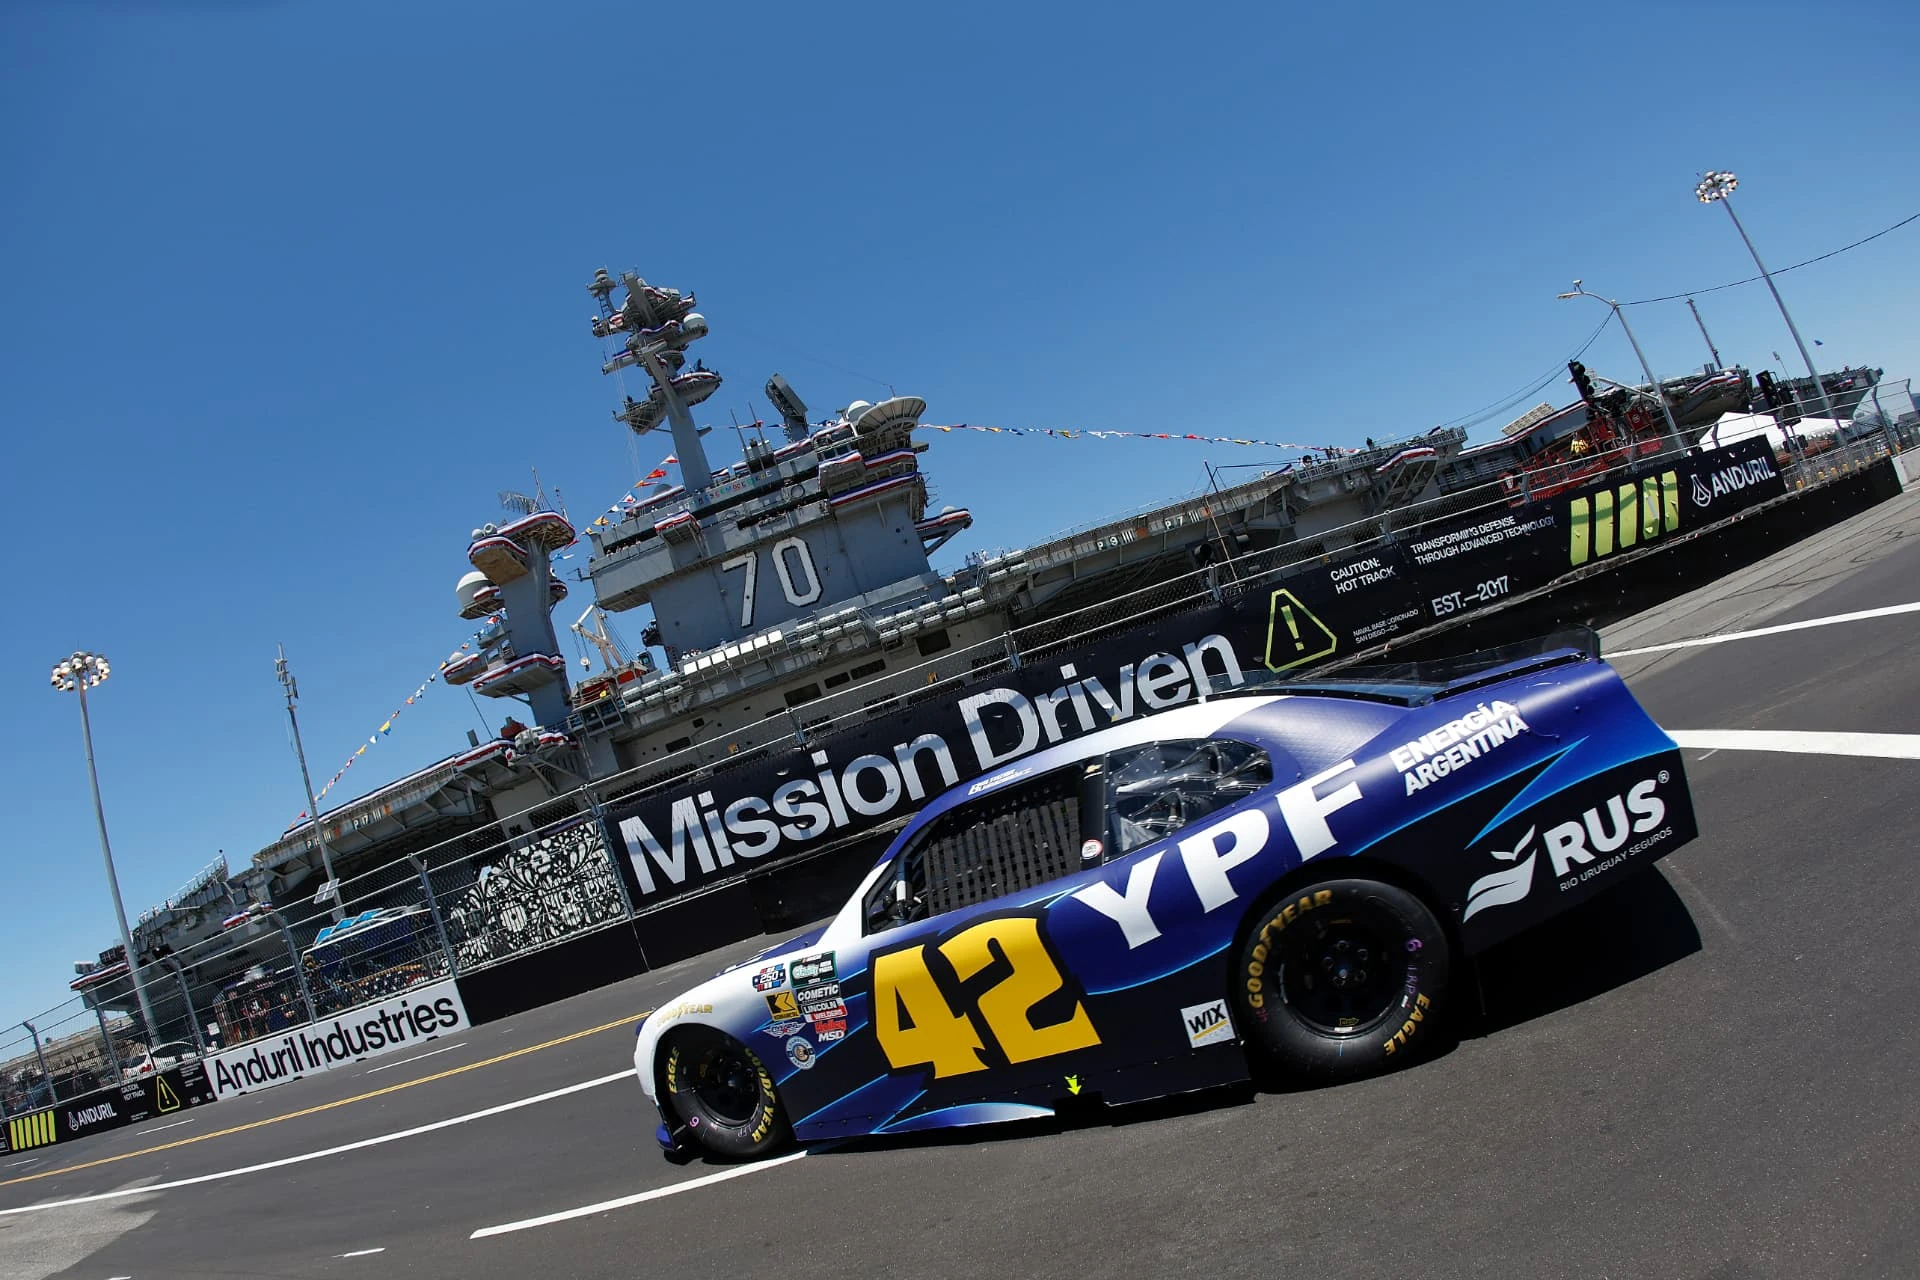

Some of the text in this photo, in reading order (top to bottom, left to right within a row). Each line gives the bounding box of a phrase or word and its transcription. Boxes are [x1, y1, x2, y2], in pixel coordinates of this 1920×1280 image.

[1711, 456, 1776, 497] ANDURIL
[1410, 515, 1516, 554] TRANSFORMING DEFENSE
[1414, 515, 1555, 565] THROUGH ADVANCED TECHNOLOGY
[721, 536, 823, 629] 70
[1330, 557, 1381, 581] CAUTION:
[1335, 565, 1396, 594] HOT TRACK
[1353, 608, 1419, 637] NAVAL BASE CORONADO
[1355, 634, 1368, 644] SAN
[618, 634, 1246, 895] Mission Driven
[1404, 714, 1530, 797] ARGENTINA
[1071, 758, 1364, 950] YPF
[1560, 826, 1673, 892] RIO URUGUAY SEGUROS
[760, 970, 779, 984] 250
[797, 983, 840, 1001] COMETIC
[803, 1000, 838, 1014] LINCOLN
[874, 918, 1103, 1079] 42
[1188, 1003, 1227, 1034] WIX
[818, 1030, 845, 1042] MSD
[1383, 992, 1431, 1056] EAGLE
[214, 997, 459, 1094] Anduril Industries
[667, 1046, 680, 1094] EAGLE
[78, 1102, 117, 1126] ANDURIL
